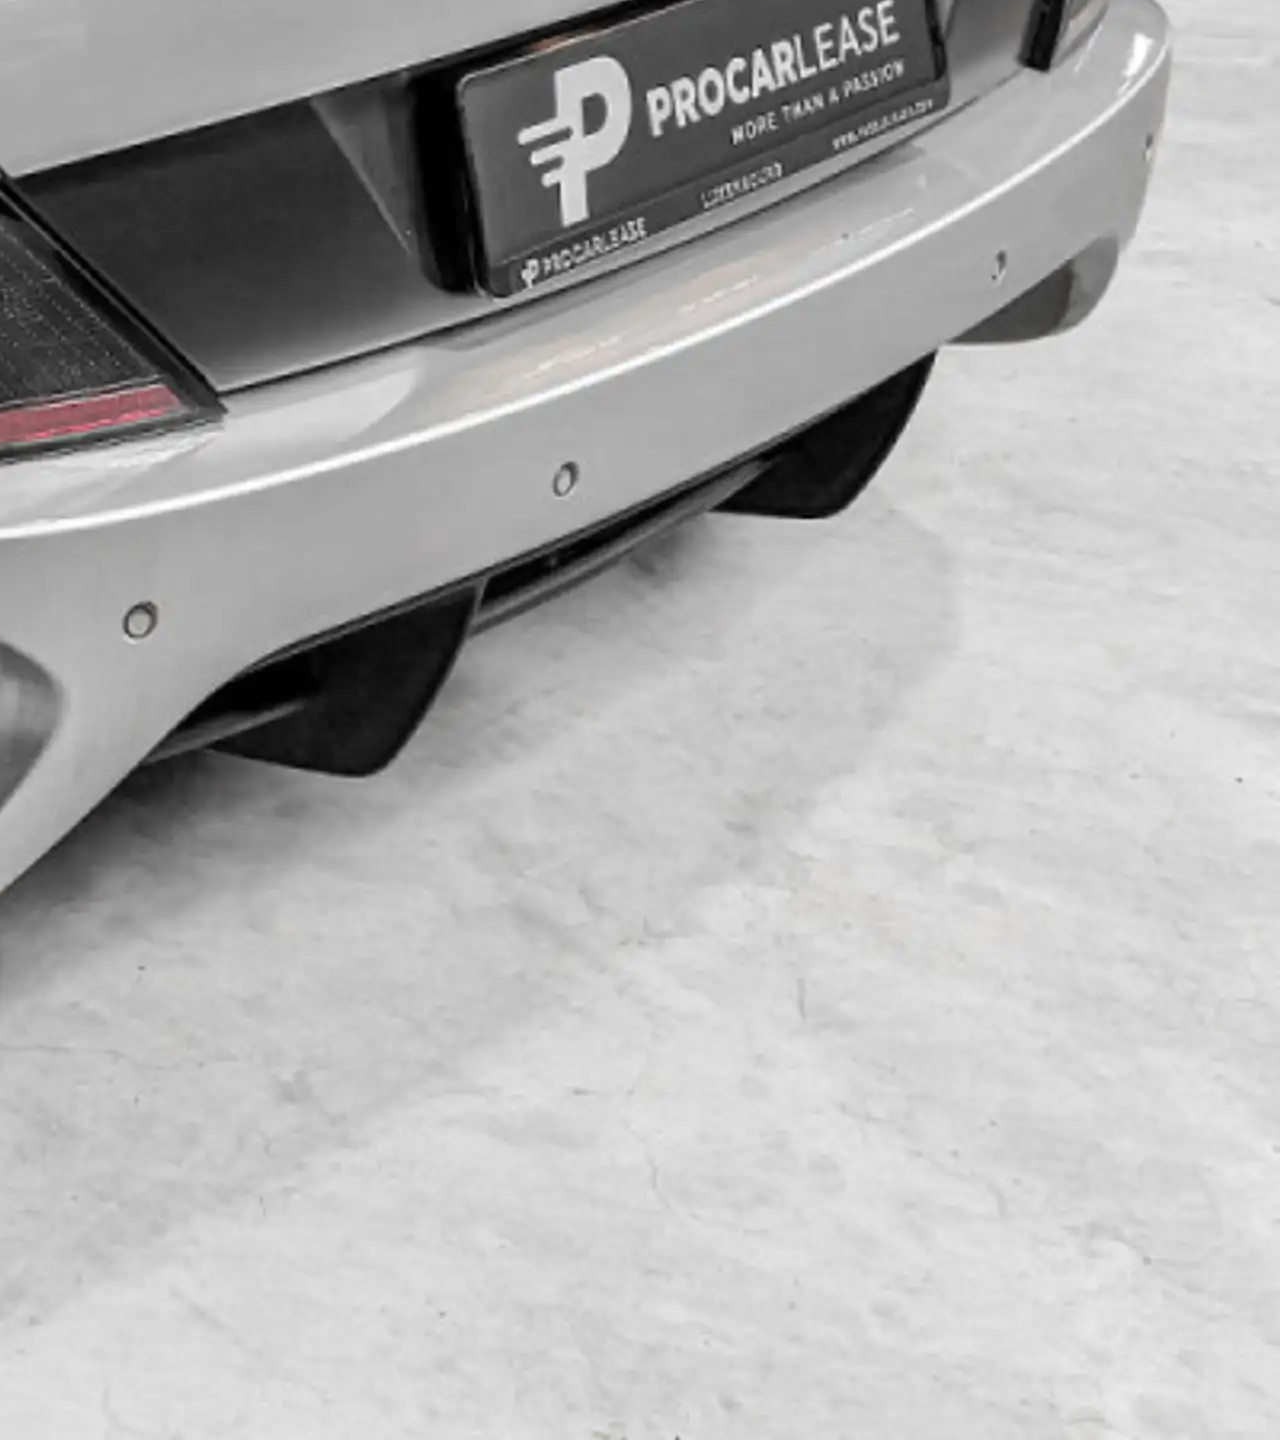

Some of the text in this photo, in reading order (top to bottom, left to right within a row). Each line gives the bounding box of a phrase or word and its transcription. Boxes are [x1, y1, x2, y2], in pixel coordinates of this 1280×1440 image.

[731, 59, 905, 145] MORE THAN A PASSION
[544, 216, 648, 276] PROCARLEASE
